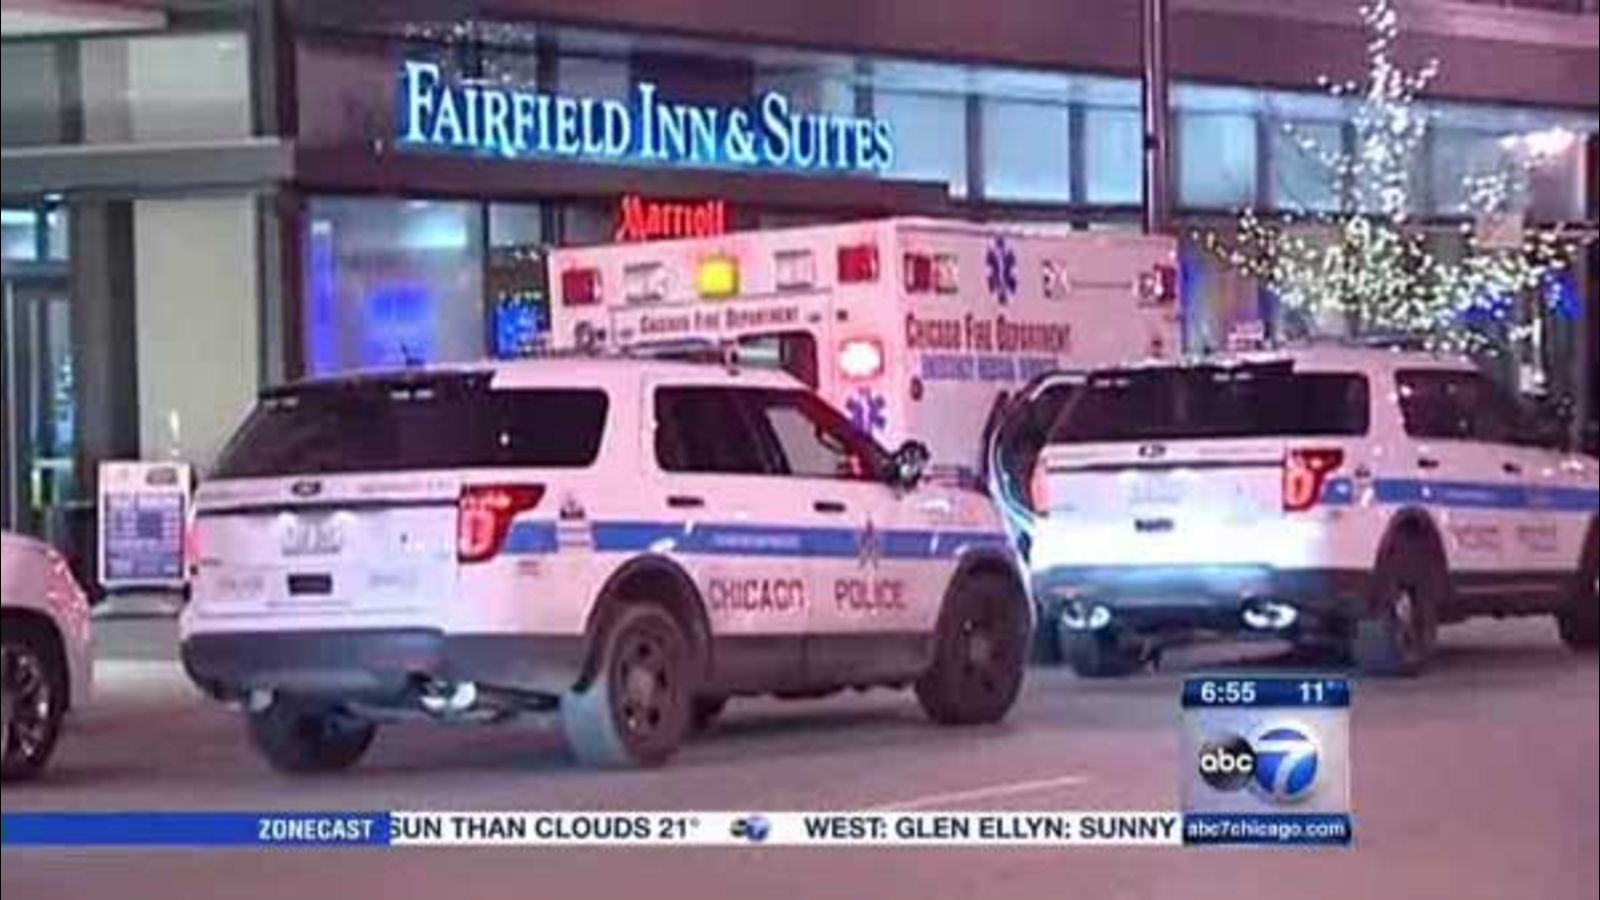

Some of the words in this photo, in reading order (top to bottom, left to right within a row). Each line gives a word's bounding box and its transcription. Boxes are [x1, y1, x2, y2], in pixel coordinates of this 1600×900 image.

[405, 59, 632, 158] FAIRFIELD
[638, 82, 718, 161] INN
[724, 108, 758, 164] &
[762, 91, 894, 170] SUITES
[708, 578, 806, 612] CHICAGO
[834, 578, 907, 613] POLICE
